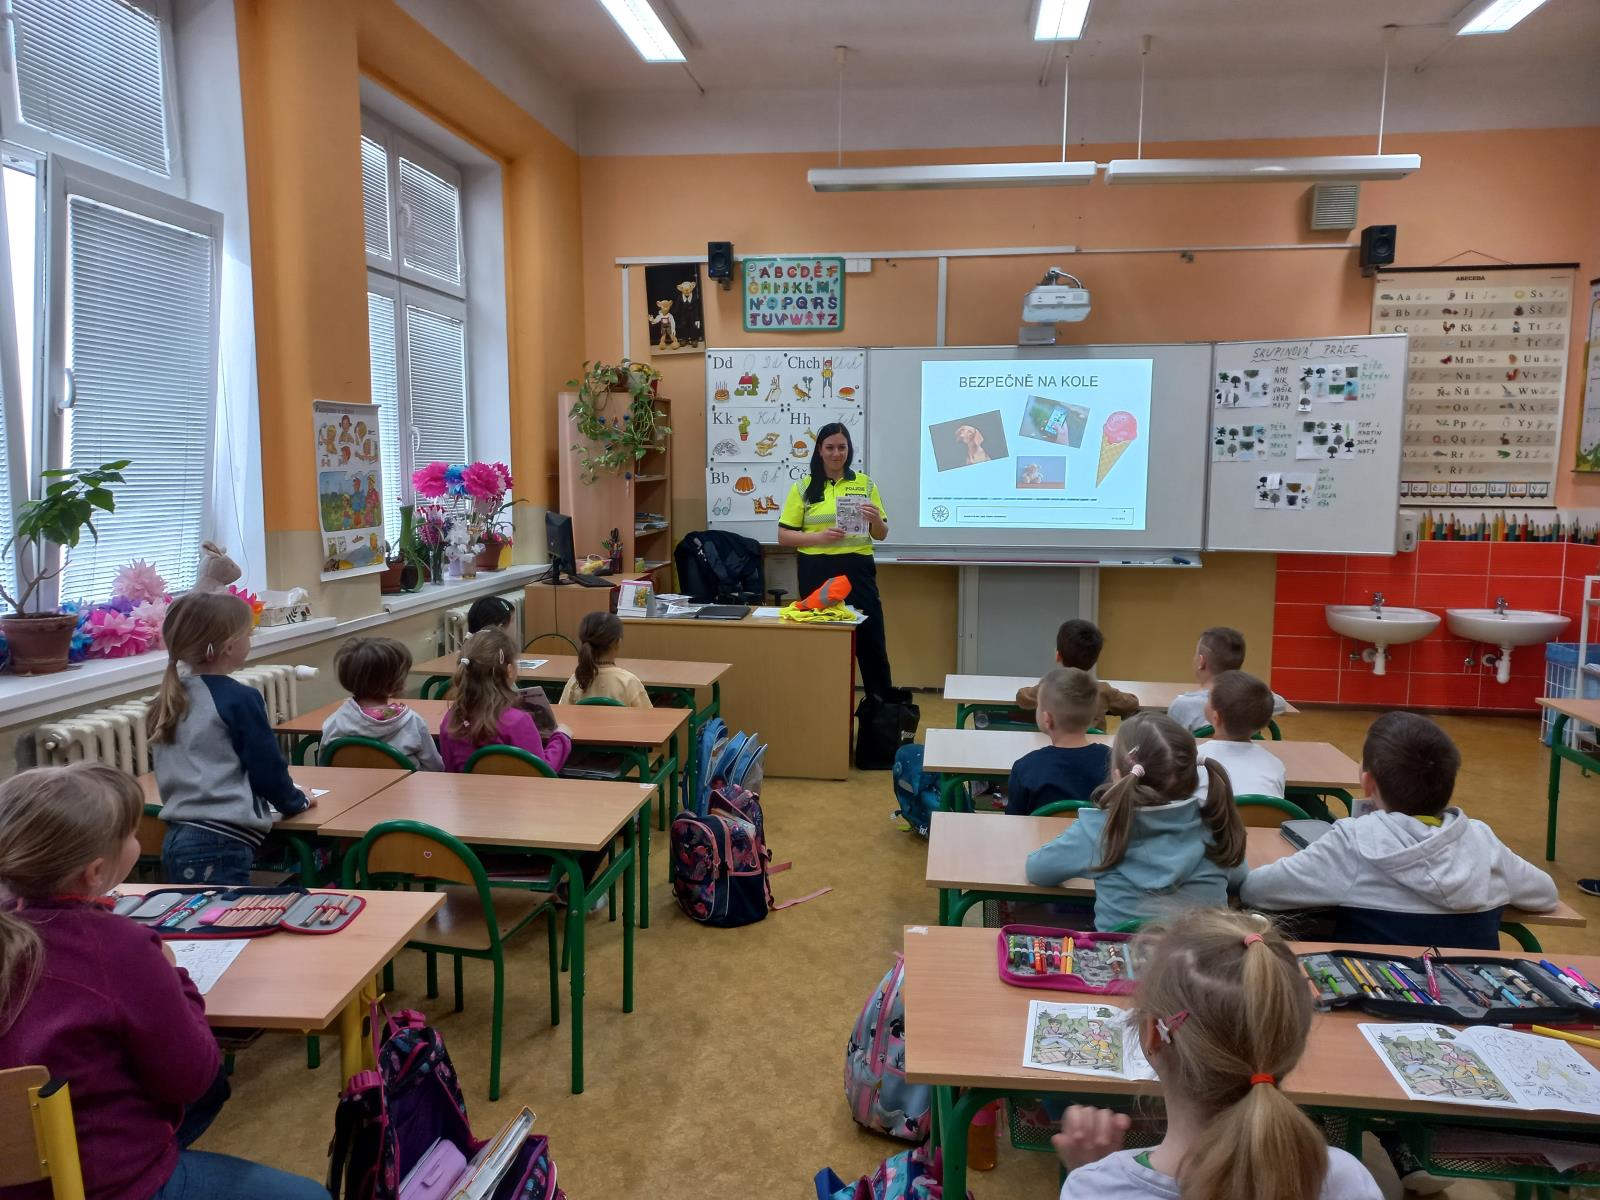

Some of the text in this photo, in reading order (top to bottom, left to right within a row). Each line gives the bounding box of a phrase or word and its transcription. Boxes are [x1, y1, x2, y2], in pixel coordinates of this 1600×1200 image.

[788, 355, 820, 369] Chch
[959, 374, 1099, 388] BEZPEČNĚ NA KOLE
